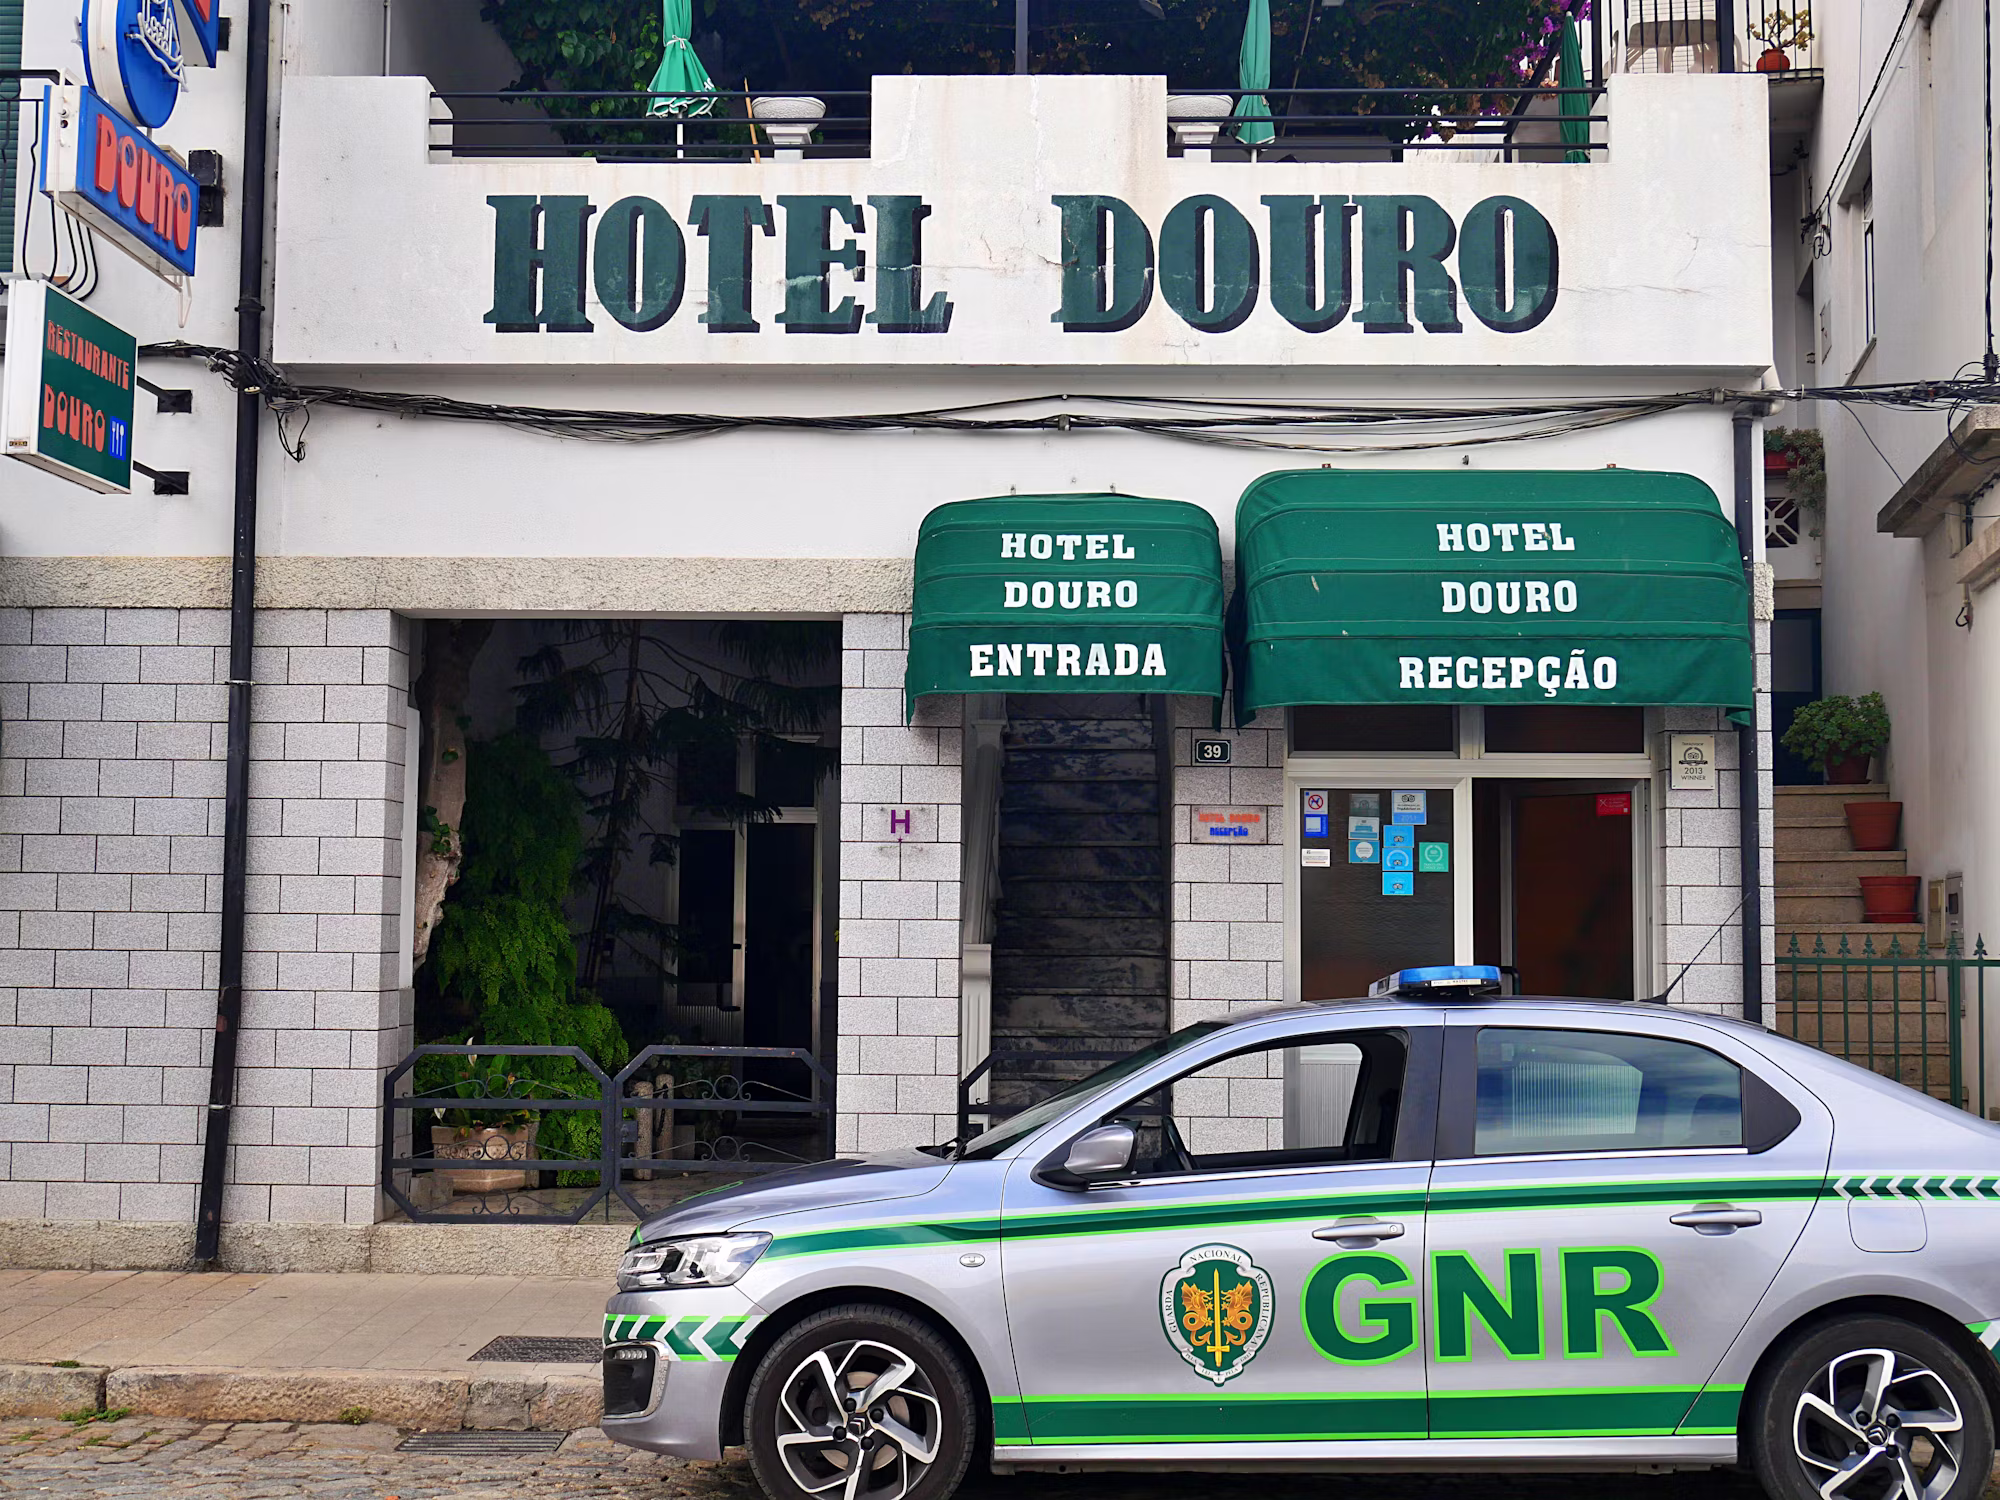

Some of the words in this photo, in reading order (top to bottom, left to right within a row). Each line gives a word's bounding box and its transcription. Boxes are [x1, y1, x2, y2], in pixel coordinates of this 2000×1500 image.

[94, 113, 192, 252] DOURO
[483, 195, 954, 333] HOTEL
[1049, 194, 1559, 333] DOURO
[46, 319, 130, 391] RESTAURANTE
[43, 383, 106, 453] DOURO
[1000, 533, 1135, 560] HOTEL
[1436, 523, 1576, 552] HOTEL
[1003, 580, 1138, 610] DOURO
[1441, 580, 1578, 615] DOURO
[969, 643, 1167, 678] ENTRADA
[1398, 648, 1618, 698] RECEPÇÃO
[1203, 744, 1222, 759] 39
[1684, 767, 1703, 775] 2013
[890, 809, 911, 834] H
[1189, 1249, 1244, 1264] NACIONAL
[1165, 1289, 1178, 1333] GUARDA
[1250, 1272, 1270, 1346] REPUBLICANA
[1300, 1245, 1679, 1367] GNR
